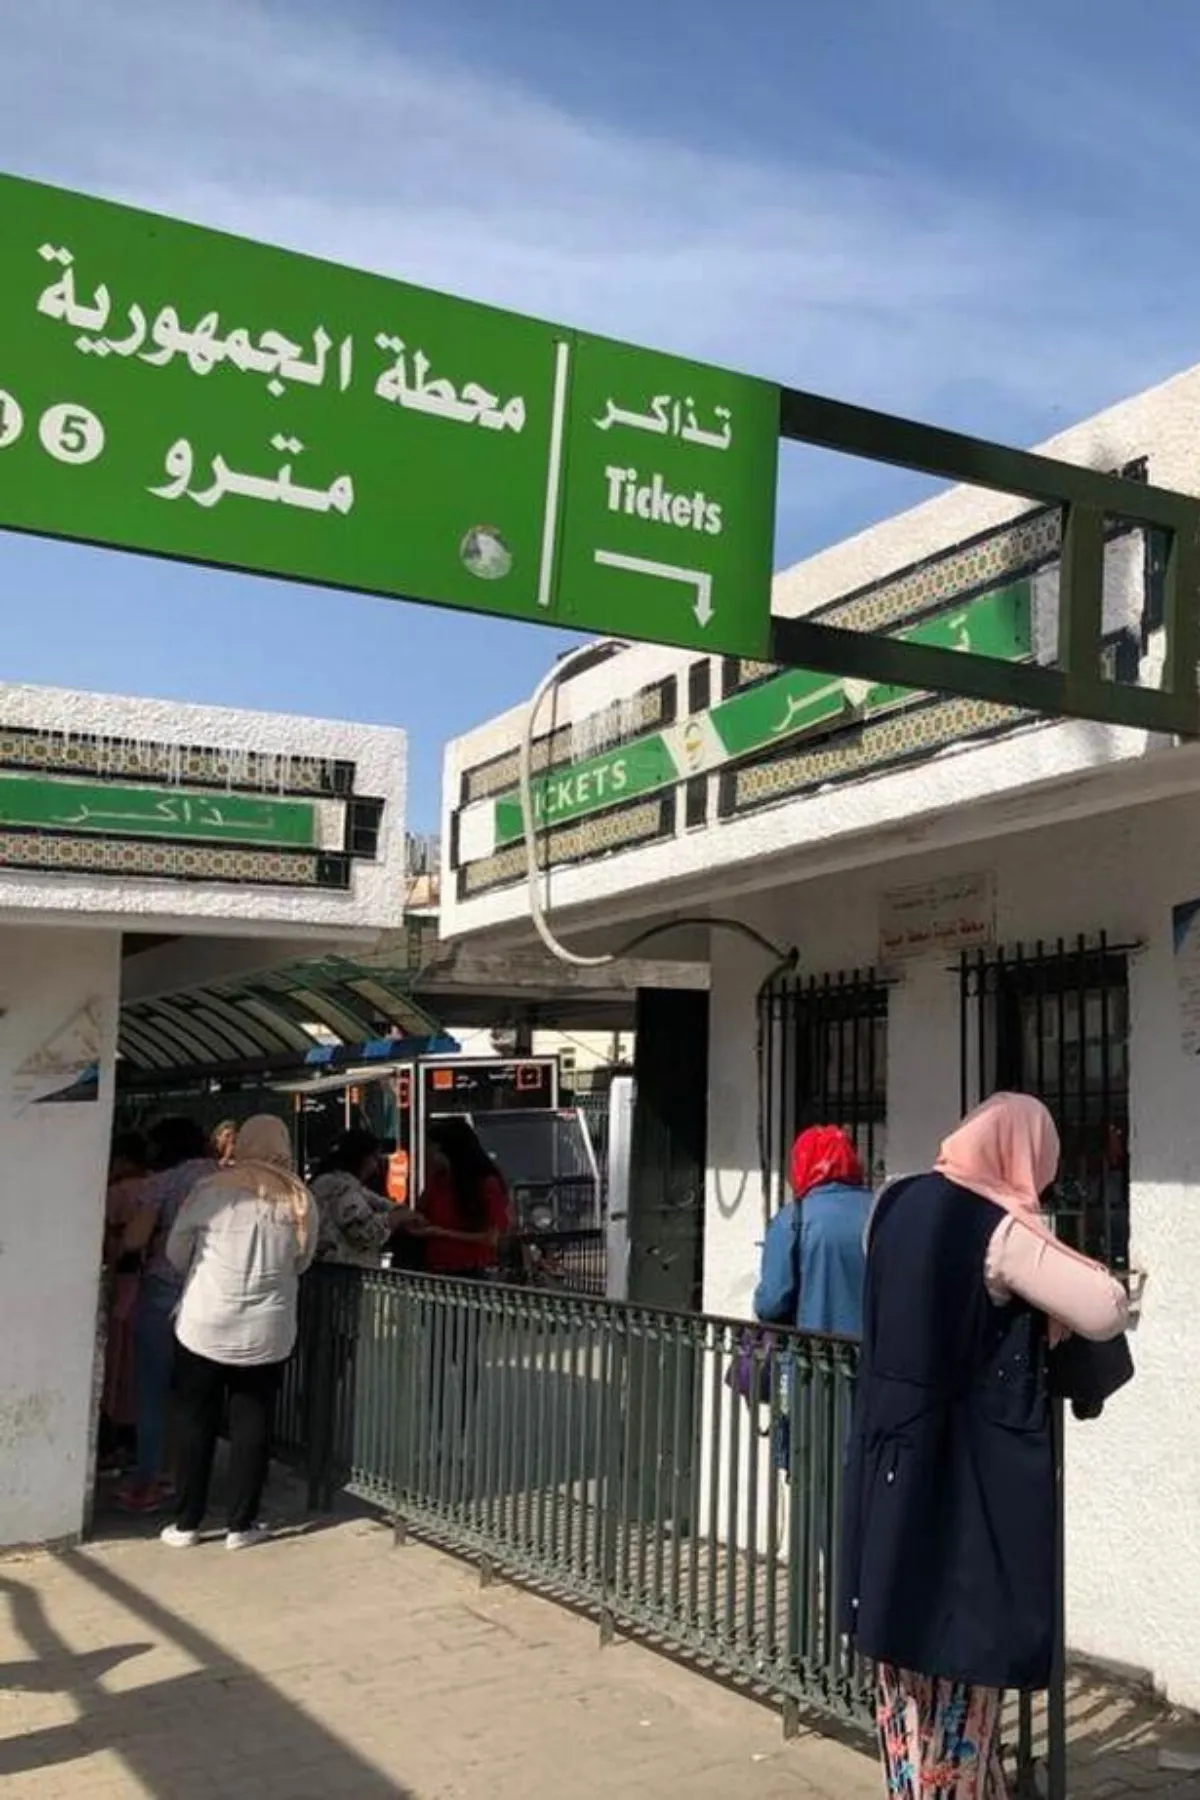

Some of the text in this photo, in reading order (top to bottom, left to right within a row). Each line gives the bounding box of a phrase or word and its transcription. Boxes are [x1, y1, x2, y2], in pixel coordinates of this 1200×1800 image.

[36, 243, 526, 433] محطة الجمهورية
[593, 395, 732, 450] تذاكر
[145, 433, 354, 514] مترو
[605, 465, 723, 535] Tickets
